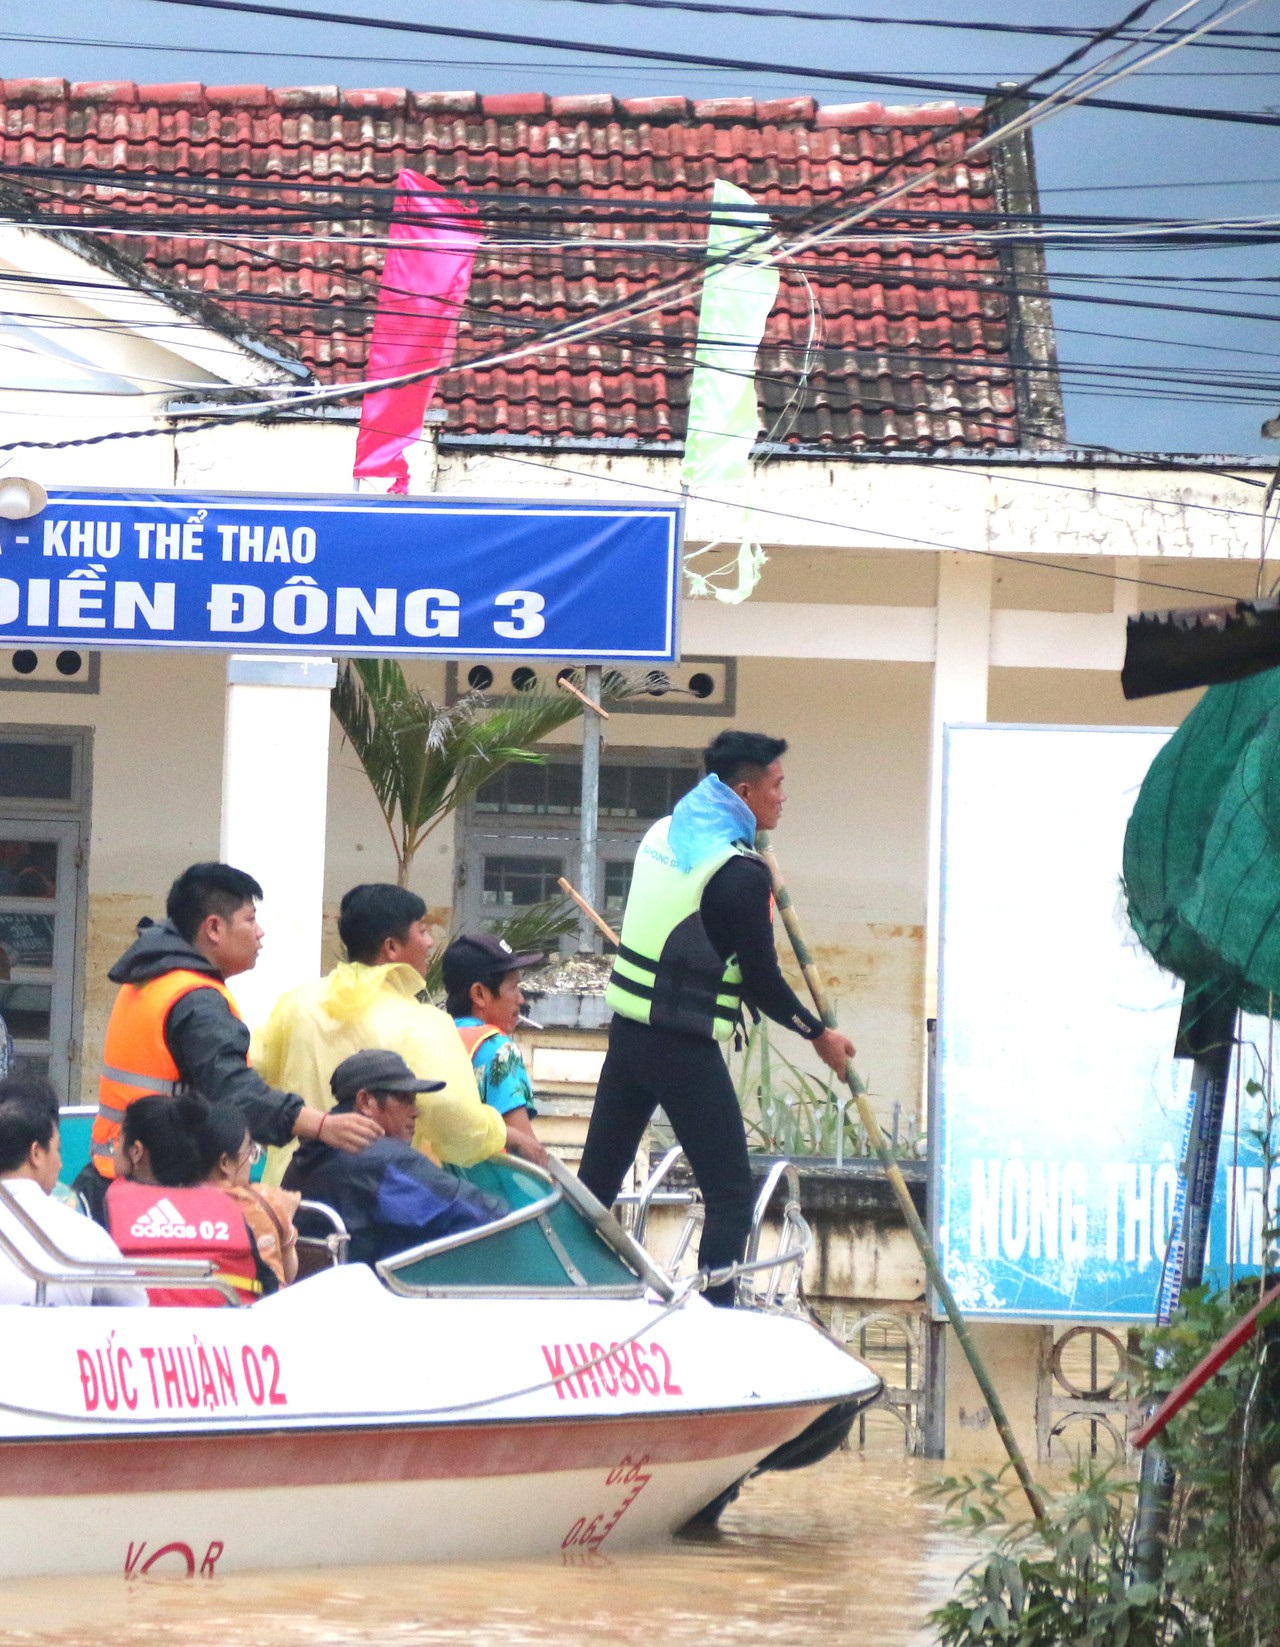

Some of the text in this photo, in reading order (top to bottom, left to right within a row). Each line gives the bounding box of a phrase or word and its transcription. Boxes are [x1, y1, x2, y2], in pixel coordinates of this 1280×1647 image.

[43, 519, 120, 560] KHU
[135, 509, 208, 561] THỂ
[217, 525, 316, 564] THAO
[207, 575, 461, 639] ĐÔNG
[493, 590, 546, 639] 3
[131, 1220, 229, 1240] adidas 02
[971, 1141, 1088, 1260] NÔNG
[1104, 1141, 1211, 1264] THÔ
[76, 1329, 138, 1412] ĐỨC
[241, 1344, 287, 1407] 02
[540, 1341, 683, 1400] KH0862
